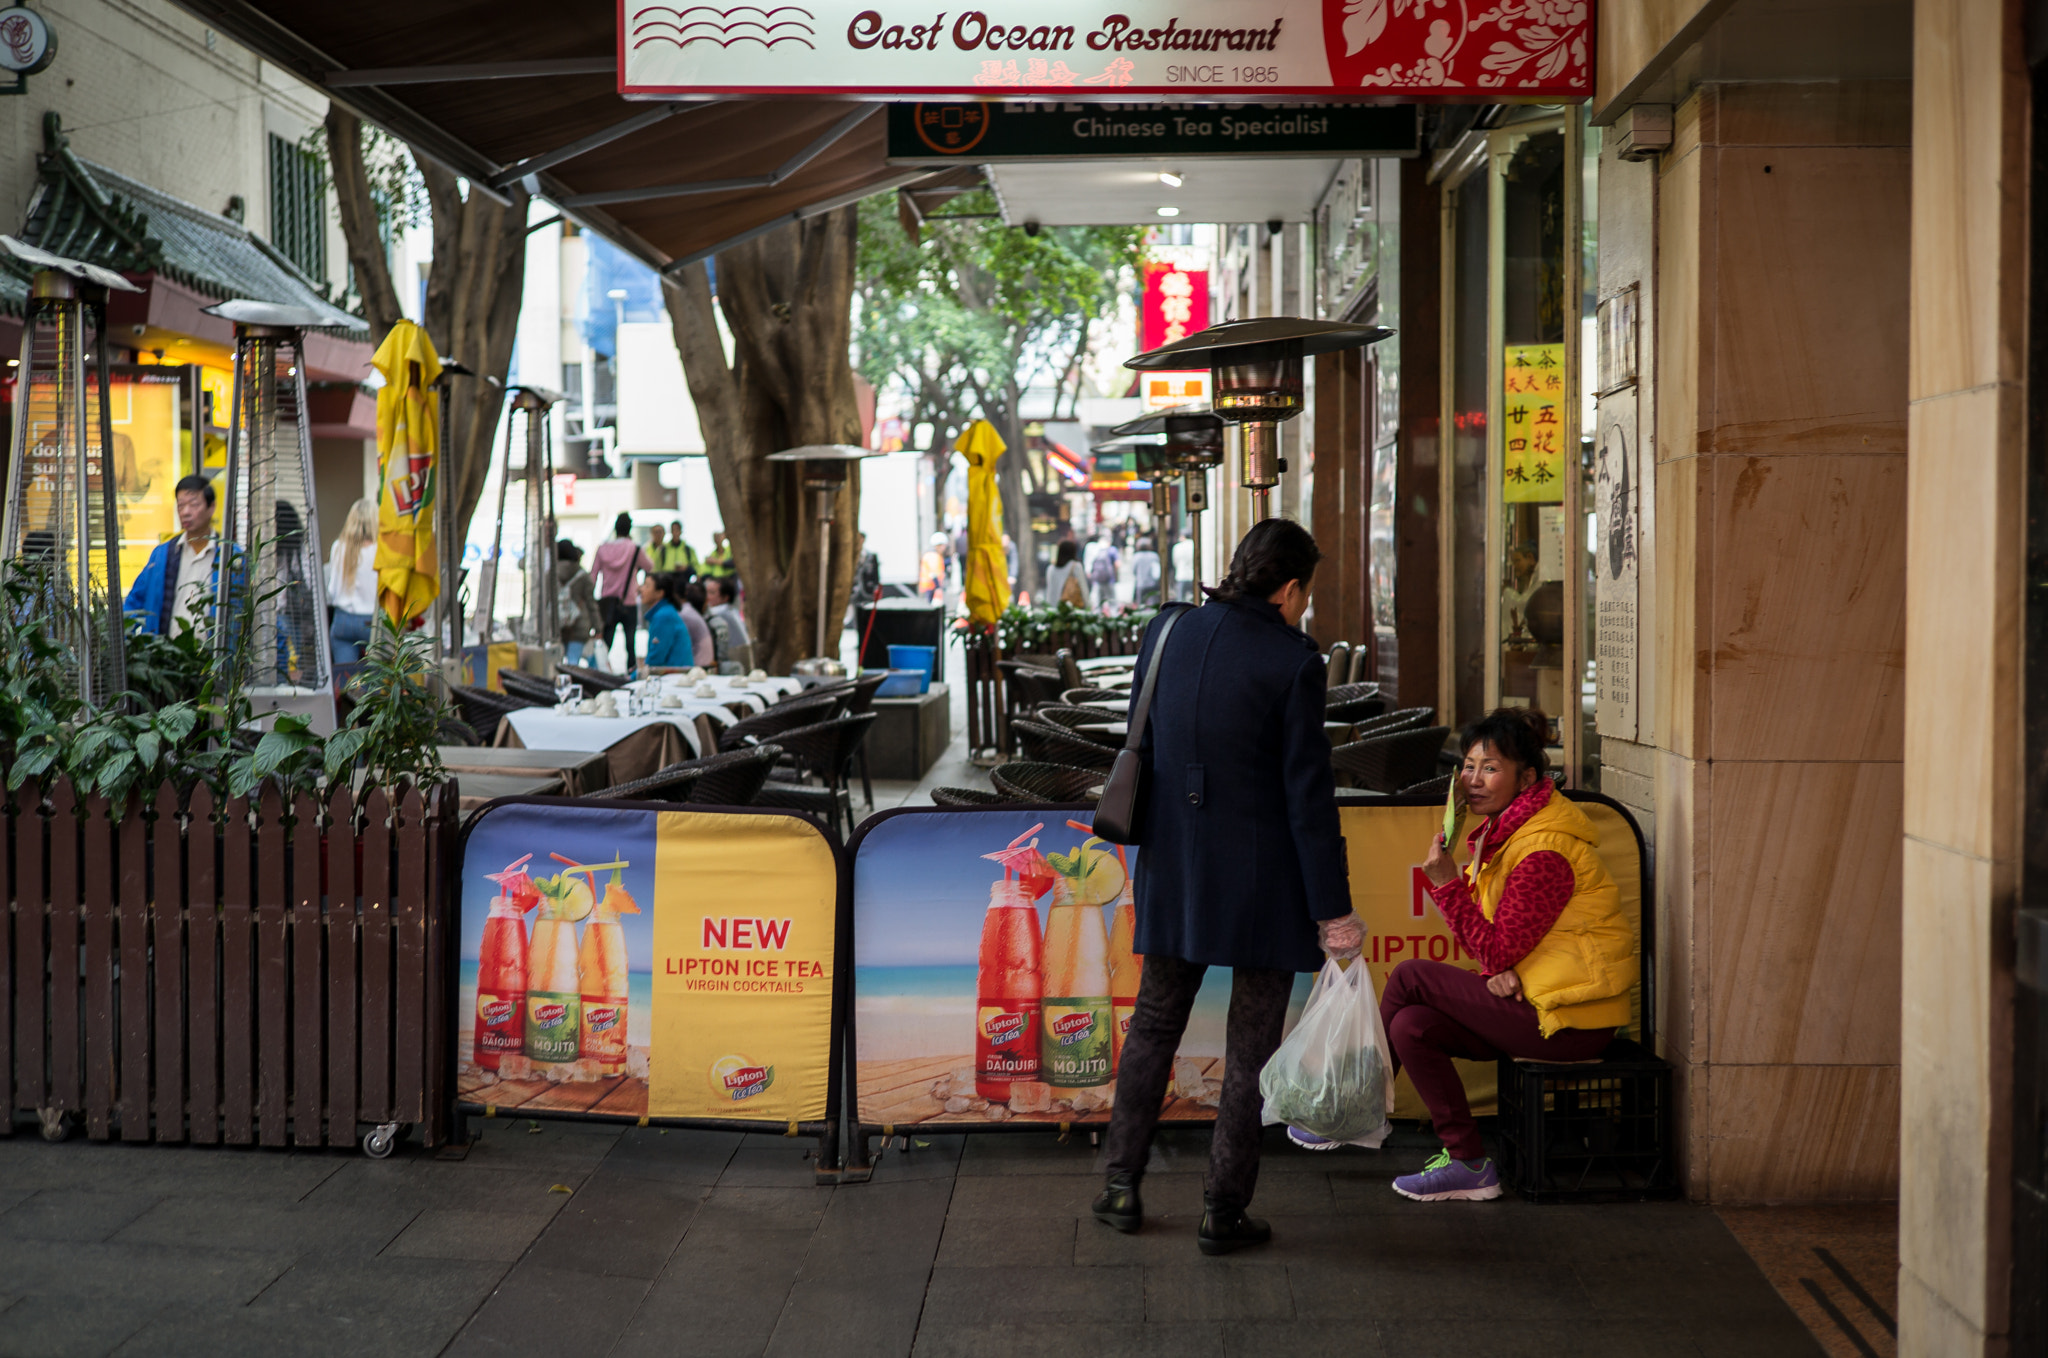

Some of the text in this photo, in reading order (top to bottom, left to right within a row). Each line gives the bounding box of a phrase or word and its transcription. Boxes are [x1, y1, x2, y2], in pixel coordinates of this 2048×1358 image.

[848, 10, 1283, 51] East Ocean Restaurant
[1166, 66, 1279, 83] SINCE 1985
[1073, 115, 1328, 140] Chinese Tea Specialist
[1506, 405, 1530, 484] 廿四味
[1531, 405, 1558, 484] 五花茶
[703, 917, 792, 950] NEW
[666, 958, 824, 978] LIPTON ICE TEA
[686, 979, 804, 993] VIRGIN COCKTAILS
[484, 1004, 510, 1016] Lipton
[536, 1006, 563, 1019] Lipton
[587, 1010, 615, 1023] Lipton
[986, 1017, 1020, 1032] Lipton
[1054, 1015, 1089, 1032] Lipton
[482, 1036, 522, 1047] DAIQUIRI
[992, 1031, 1020, 1045] Ice Tea
[1061, 1030, 1090, 1046] Ice Tea
[534, 1040, 575, 1053] MOJITO
[986, 1059, 1038, 1071] DAIQUIRI
[1054, 1058, 1107, 1073] MOJITO
[726, 1070, 763, 1086] Lipton
[733, 1084, 763, 1100] Ice Tea
